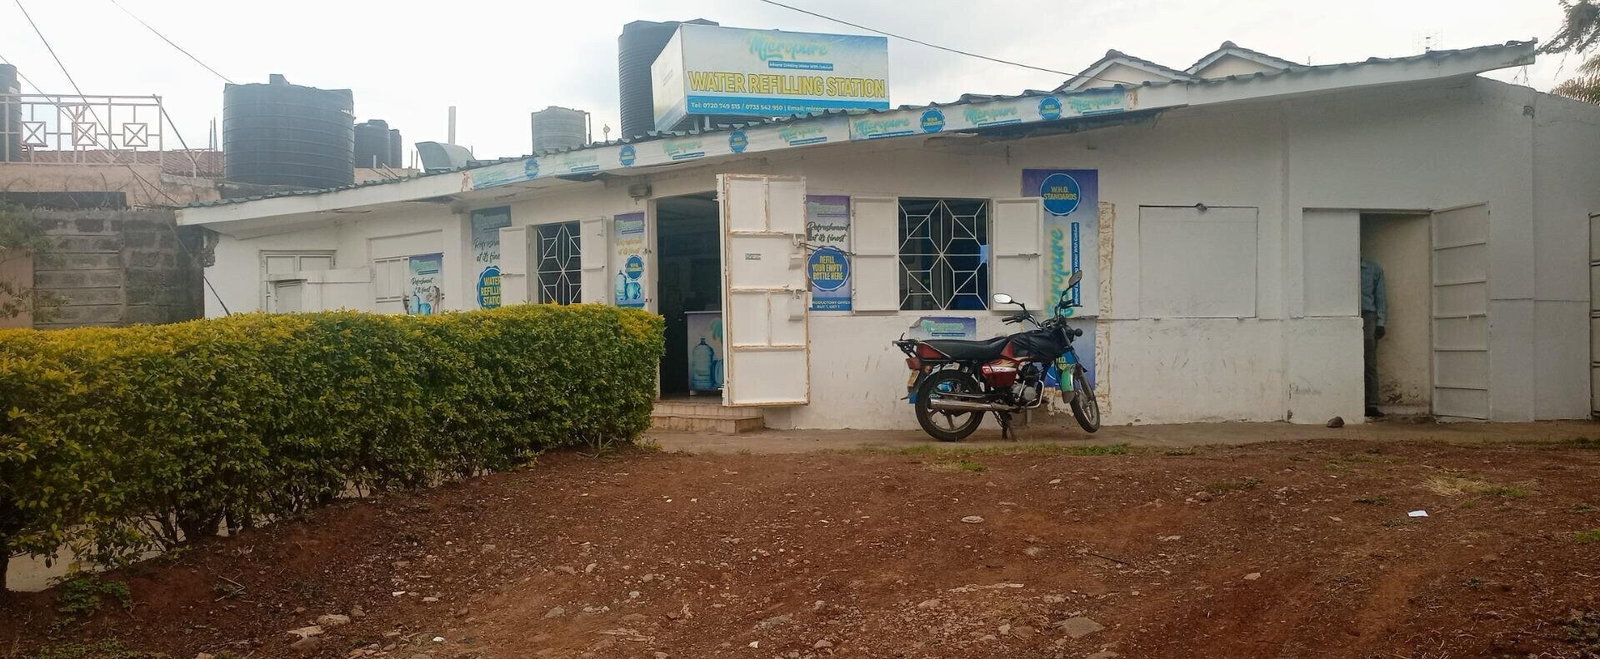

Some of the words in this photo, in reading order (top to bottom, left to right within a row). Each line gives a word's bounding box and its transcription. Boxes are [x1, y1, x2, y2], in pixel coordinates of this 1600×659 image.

[688, 70, 746, 93] WATER
[748, 74, 824, 96] REFILLING
[826, 77, 886, 98] STATION
[483, 296, 500, 305] STATIO
